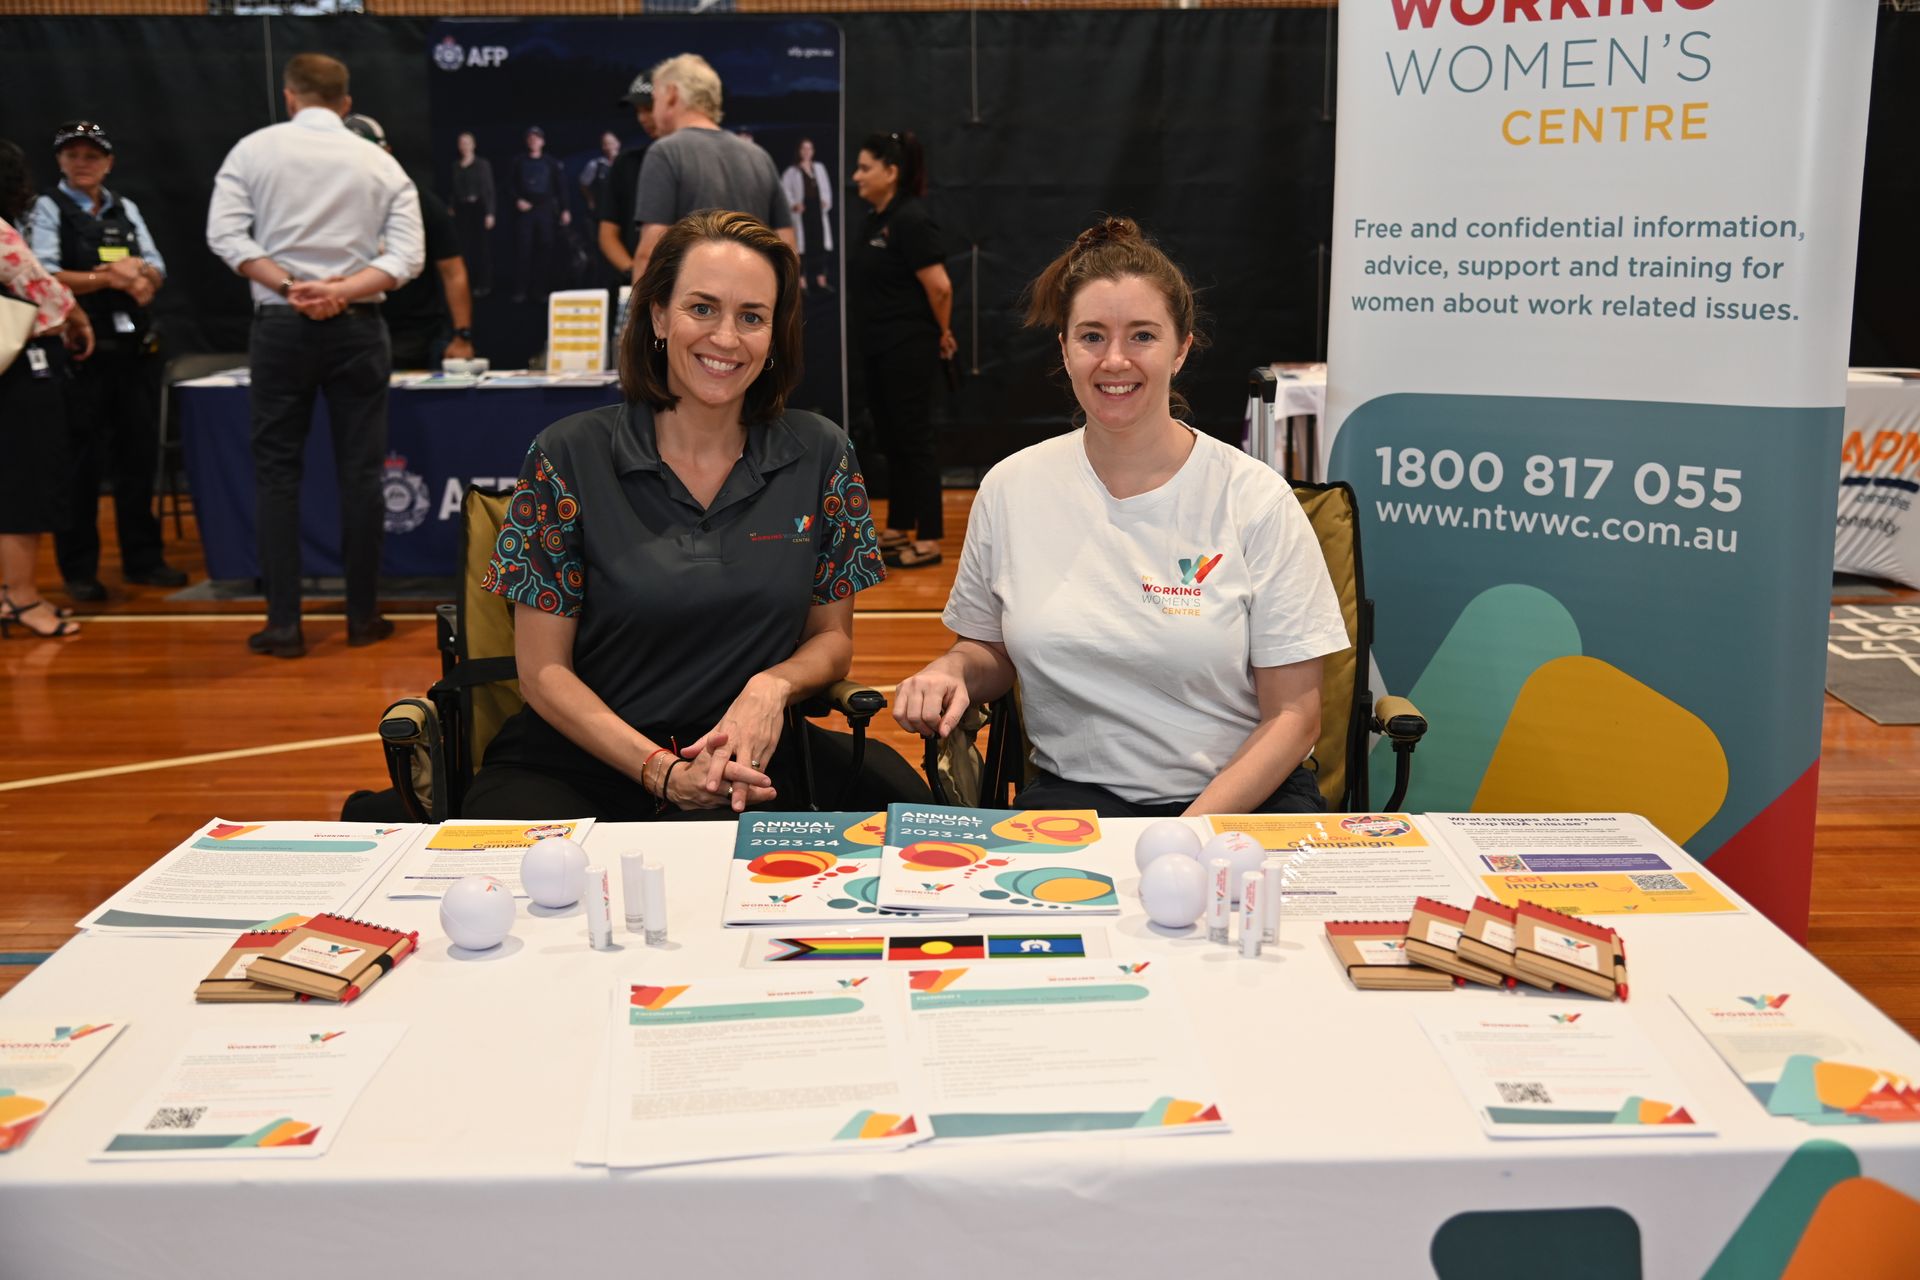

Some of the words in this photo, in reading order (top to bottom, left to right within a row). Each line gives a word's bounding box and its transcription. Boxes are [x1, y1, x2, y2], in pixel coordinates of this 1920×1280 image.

[1391, 0, 1716, 31] WORK
[466, 46, 509, 68] AFP
[1385, 30, 1712, 97] WOMEN'S
[1501, 102, 1710, 146] CENTRE
[1354, 219, 1403, 239] Free
[1411, 218, 1458, 239] and
[1466, 216, 1623, 239] confidential
[1633, 216, 1806, 241] information,
[1364, 256, 1449, 279] advice,
[1457, 257, 1561, 282] support
[1569, 256, 1619, 278] and
[1628, 257, 1732, 283] training
[1742, 257, 1785, 280] for
[1352, 295, 1435, 313] women
[1443, 293, 1519, 316] about
[1528, 295, 1593, 317] work
[1602, 296, 1697, 319] related
[1706, 297, 1800, 322] issues.
[1375, 446, 1504, 493] 1800
[1523, 455, 1615, 501] 817
[1634, 462, 1743, 513] 055
[1376, 500, 1739, 553] www.ntwwc.com.au
[1142, 583, 1202, 597] WORKING
[1142, 594, 1201, 608] WOMEN'S
[1161, 607, 1201, 617] CENTRE
[901, 811, 983, 822] ANNUAL
[901, 817, 984, 828] REPORT
[900, 828, 989, 841] 2023-24
[750, 838, 840, 847] 2023-24
[1287, 840, 1395, 850] Campaign
[1504, 874, 1544, 883] Get
[1506, 881, 1599, 889] involved
